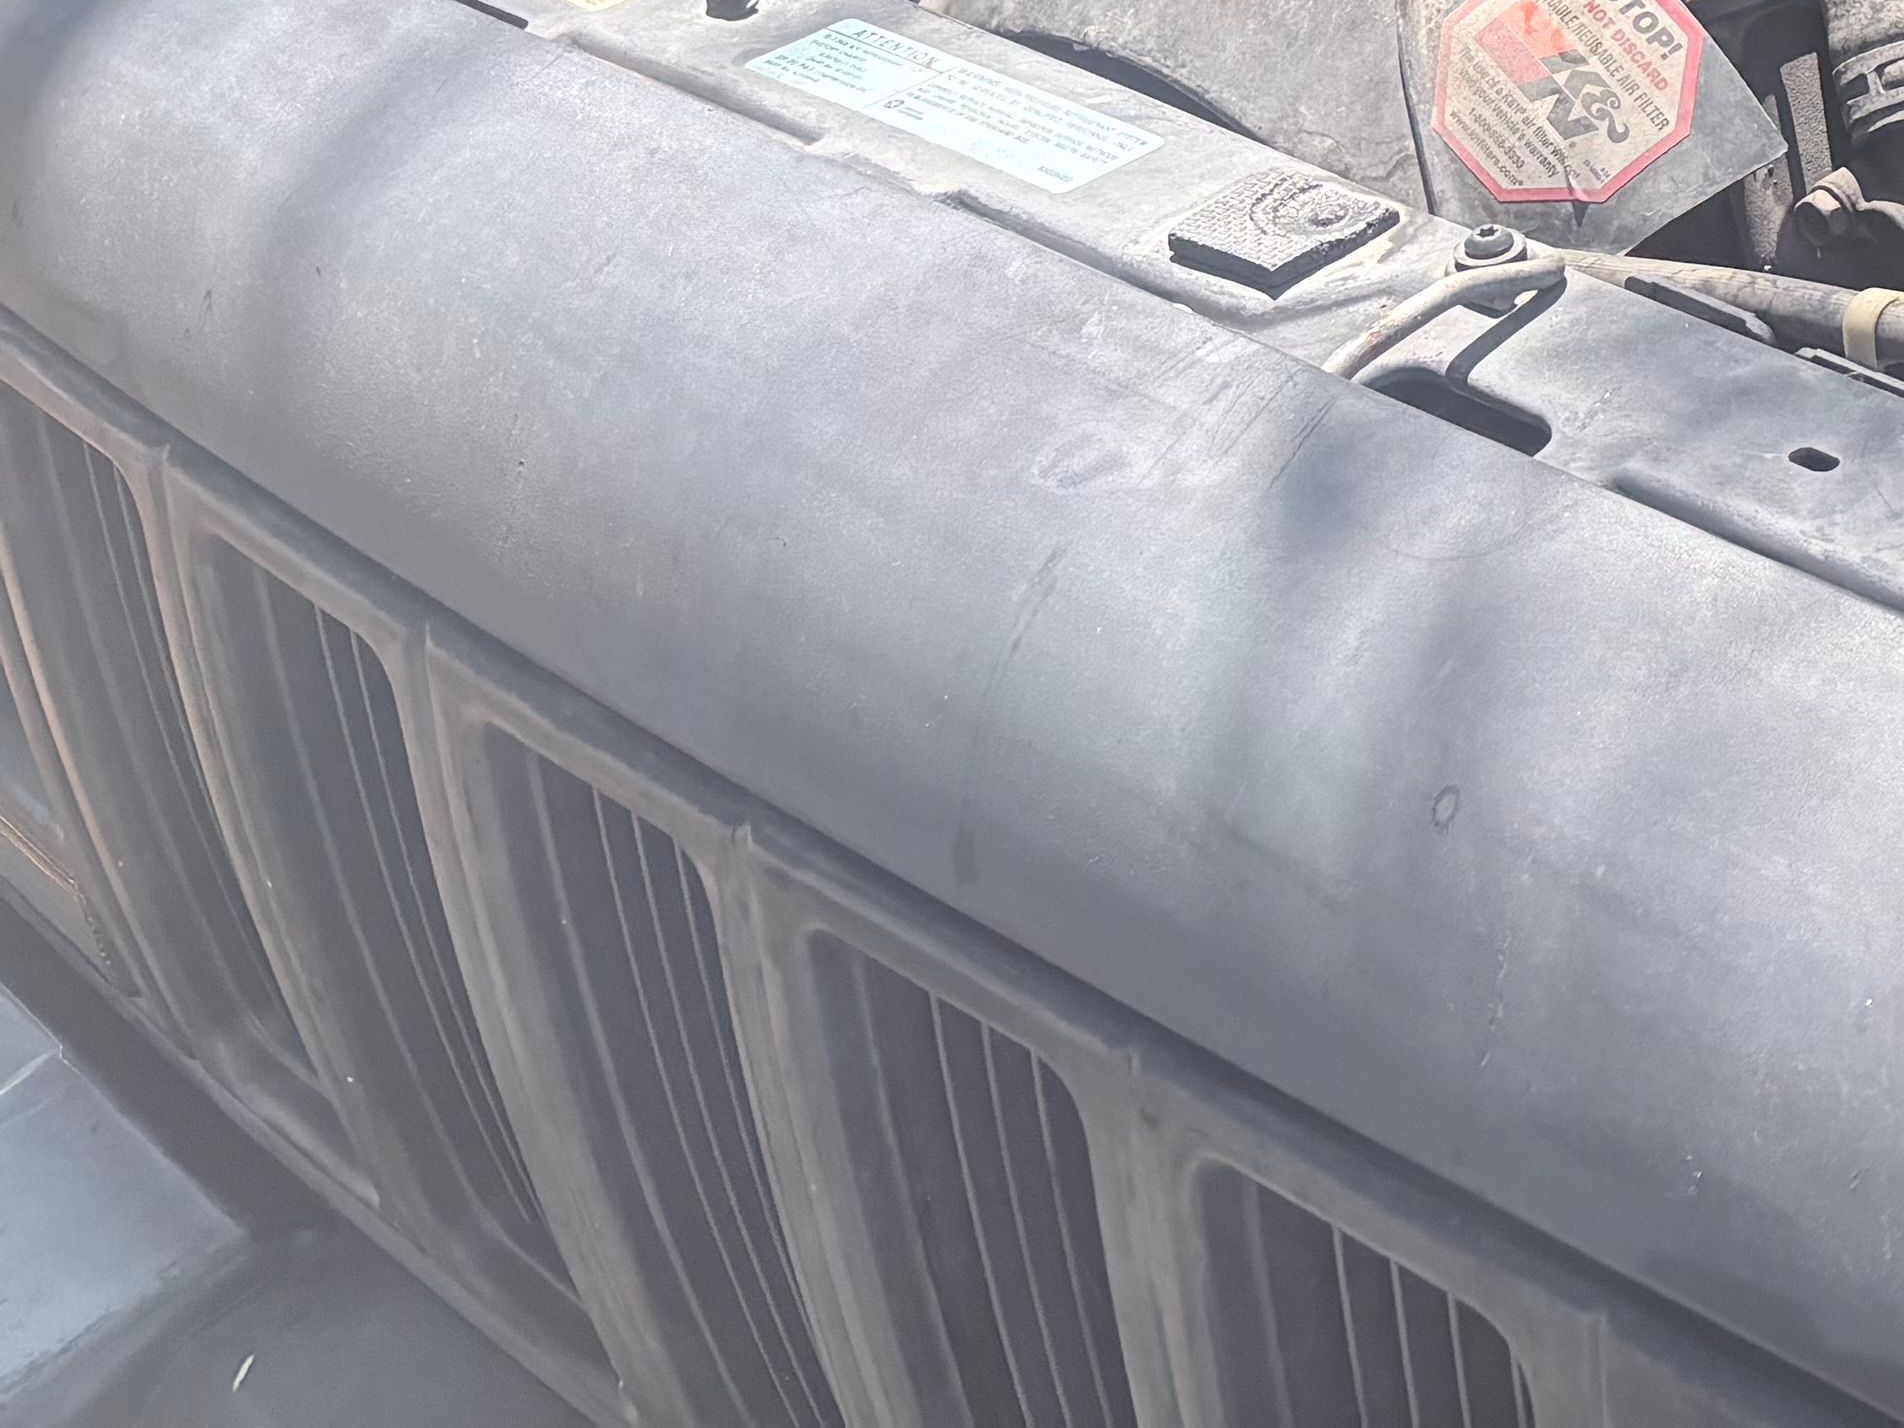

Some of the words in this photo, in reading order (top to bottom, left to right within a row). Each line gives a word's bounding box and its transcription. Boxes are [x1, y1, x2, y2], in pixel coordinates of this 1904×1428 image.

[851, 27, 937, 68] ATTENTION
[1583, 0, 1614, 30] NOT
[1612, 29, 1670, 92] DISCARD
[1616, 65, 1642, 104] AIR
[1635, 86, 1673, 132] FILTER
[1524, 137, 1560, 178] warranty
